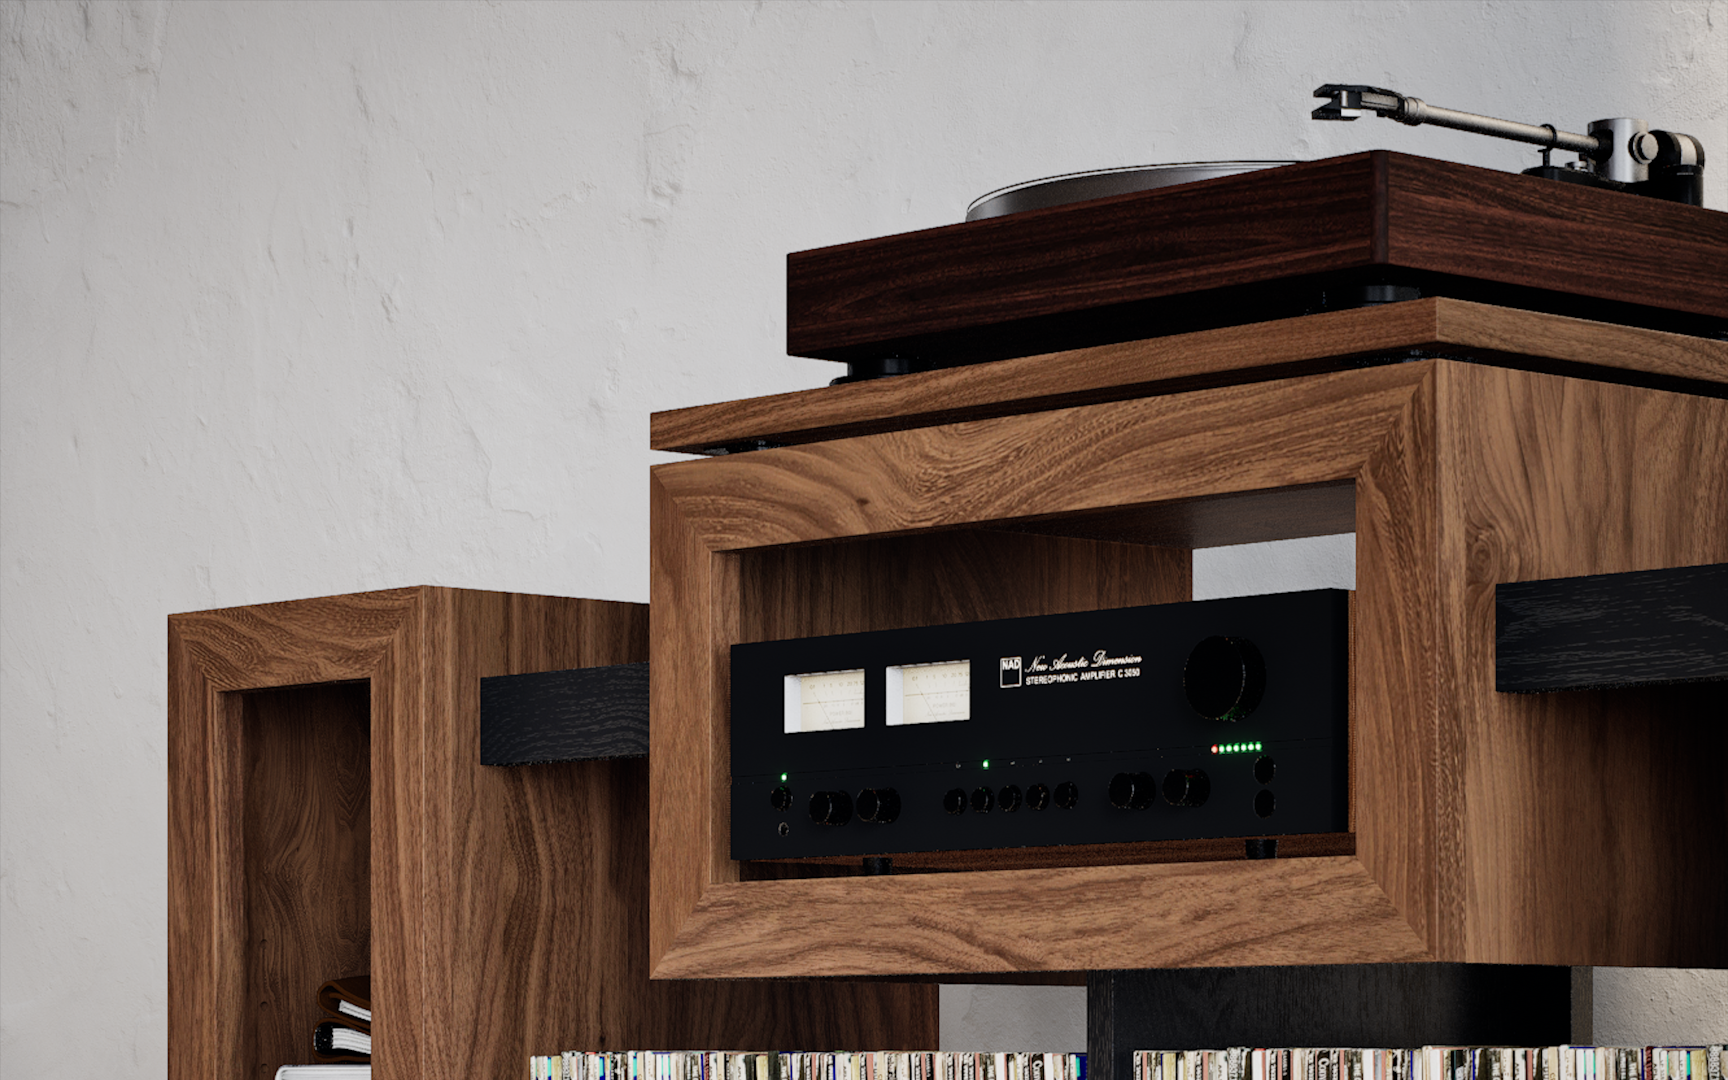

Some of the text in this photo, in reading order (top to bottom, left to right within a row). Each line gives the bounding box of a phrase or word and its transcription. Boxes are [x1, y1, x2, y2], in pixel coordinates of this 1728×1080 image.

[1002, 659, 1020, 671] NAD
[1025, 649, 1142, 673] New Acoustic Dimension
[1025, 673, 1079, 686] STEREOPHONIC
[1080, 669, 1116, 681] AMPLIFIER
[1117, 669, 1124, 678] C
